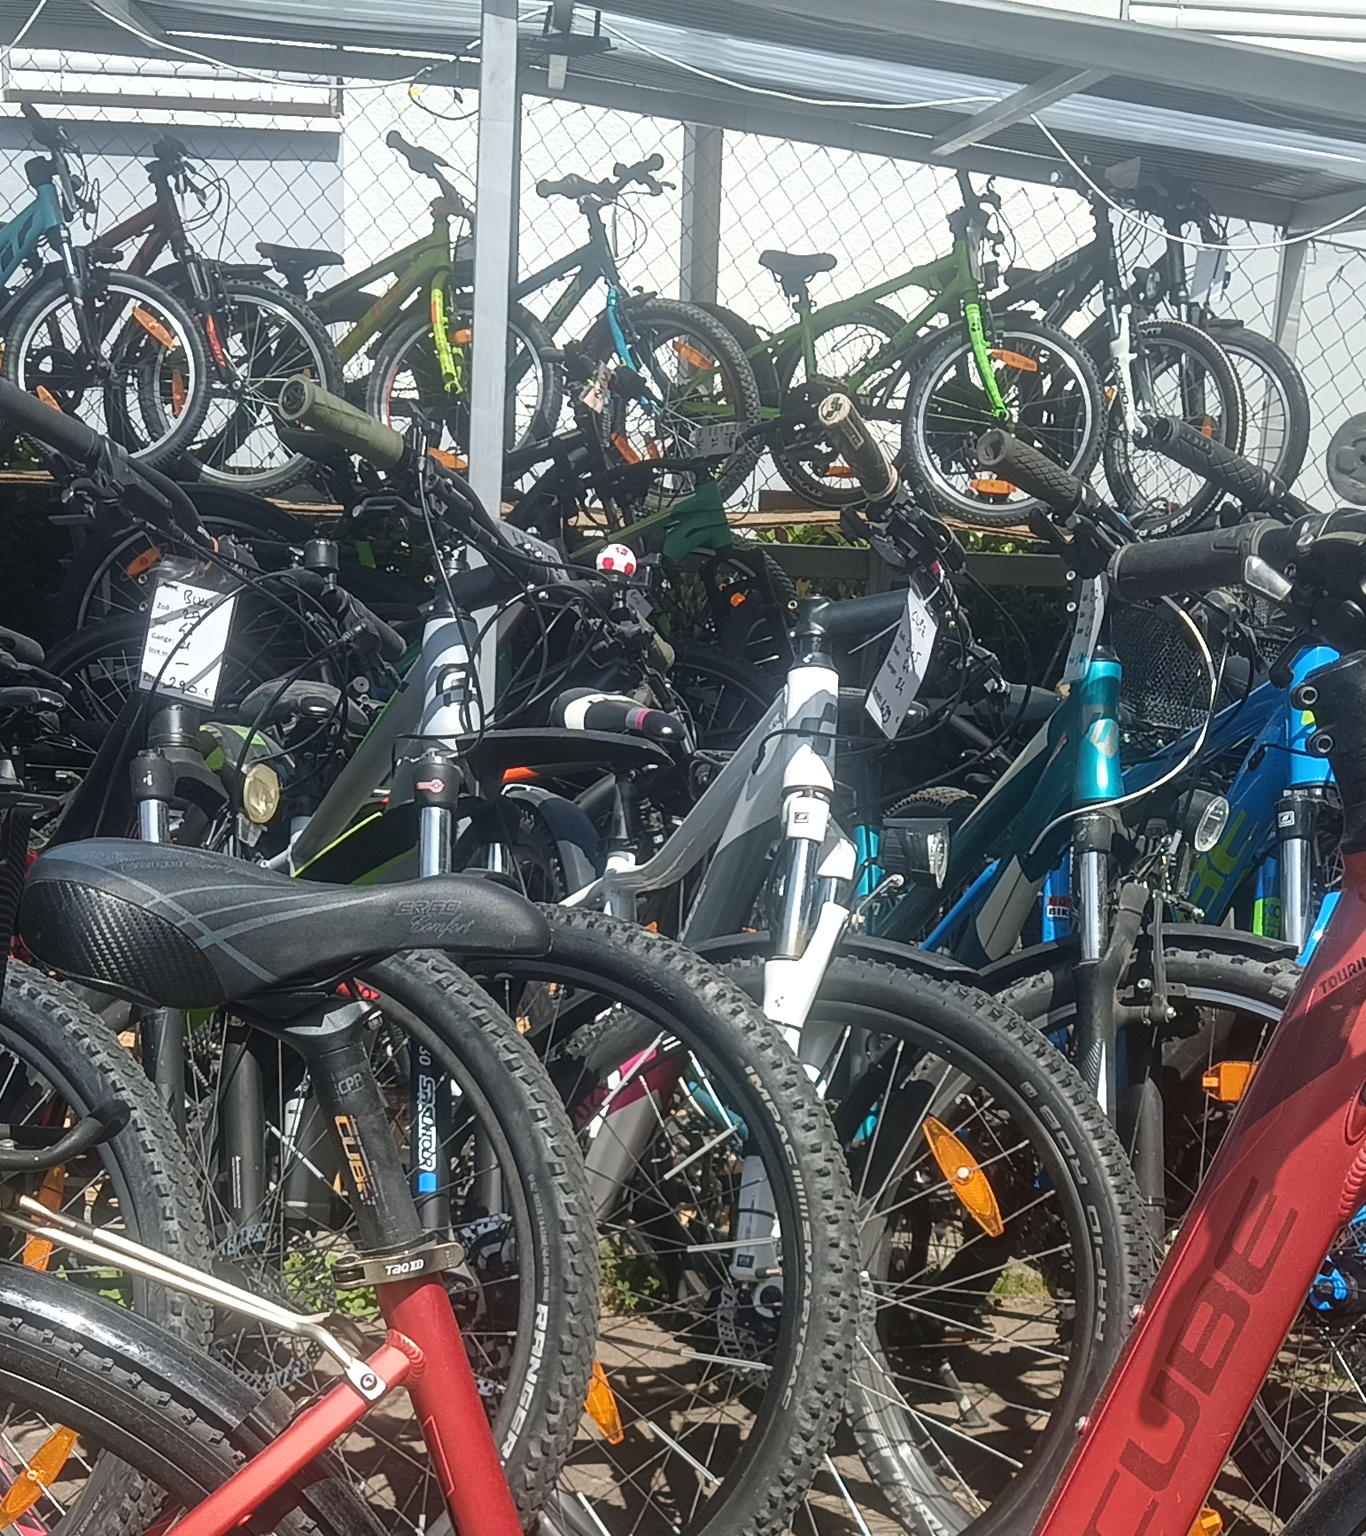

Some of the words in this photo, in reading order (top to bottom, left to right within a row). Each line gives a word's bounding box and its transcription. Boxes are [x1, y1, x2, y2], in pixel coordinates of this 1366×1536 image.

[393, 899, 462, 917] ERGO
[409, 913, 476, 939] Comfort
[337, 1072, 365, 1098] CPP
[744, 1065, 798, 1166] IMPAC
[1086, 1204, 1108, 1342] RAPID
[501, 1302, 549, 1460] RANGER
